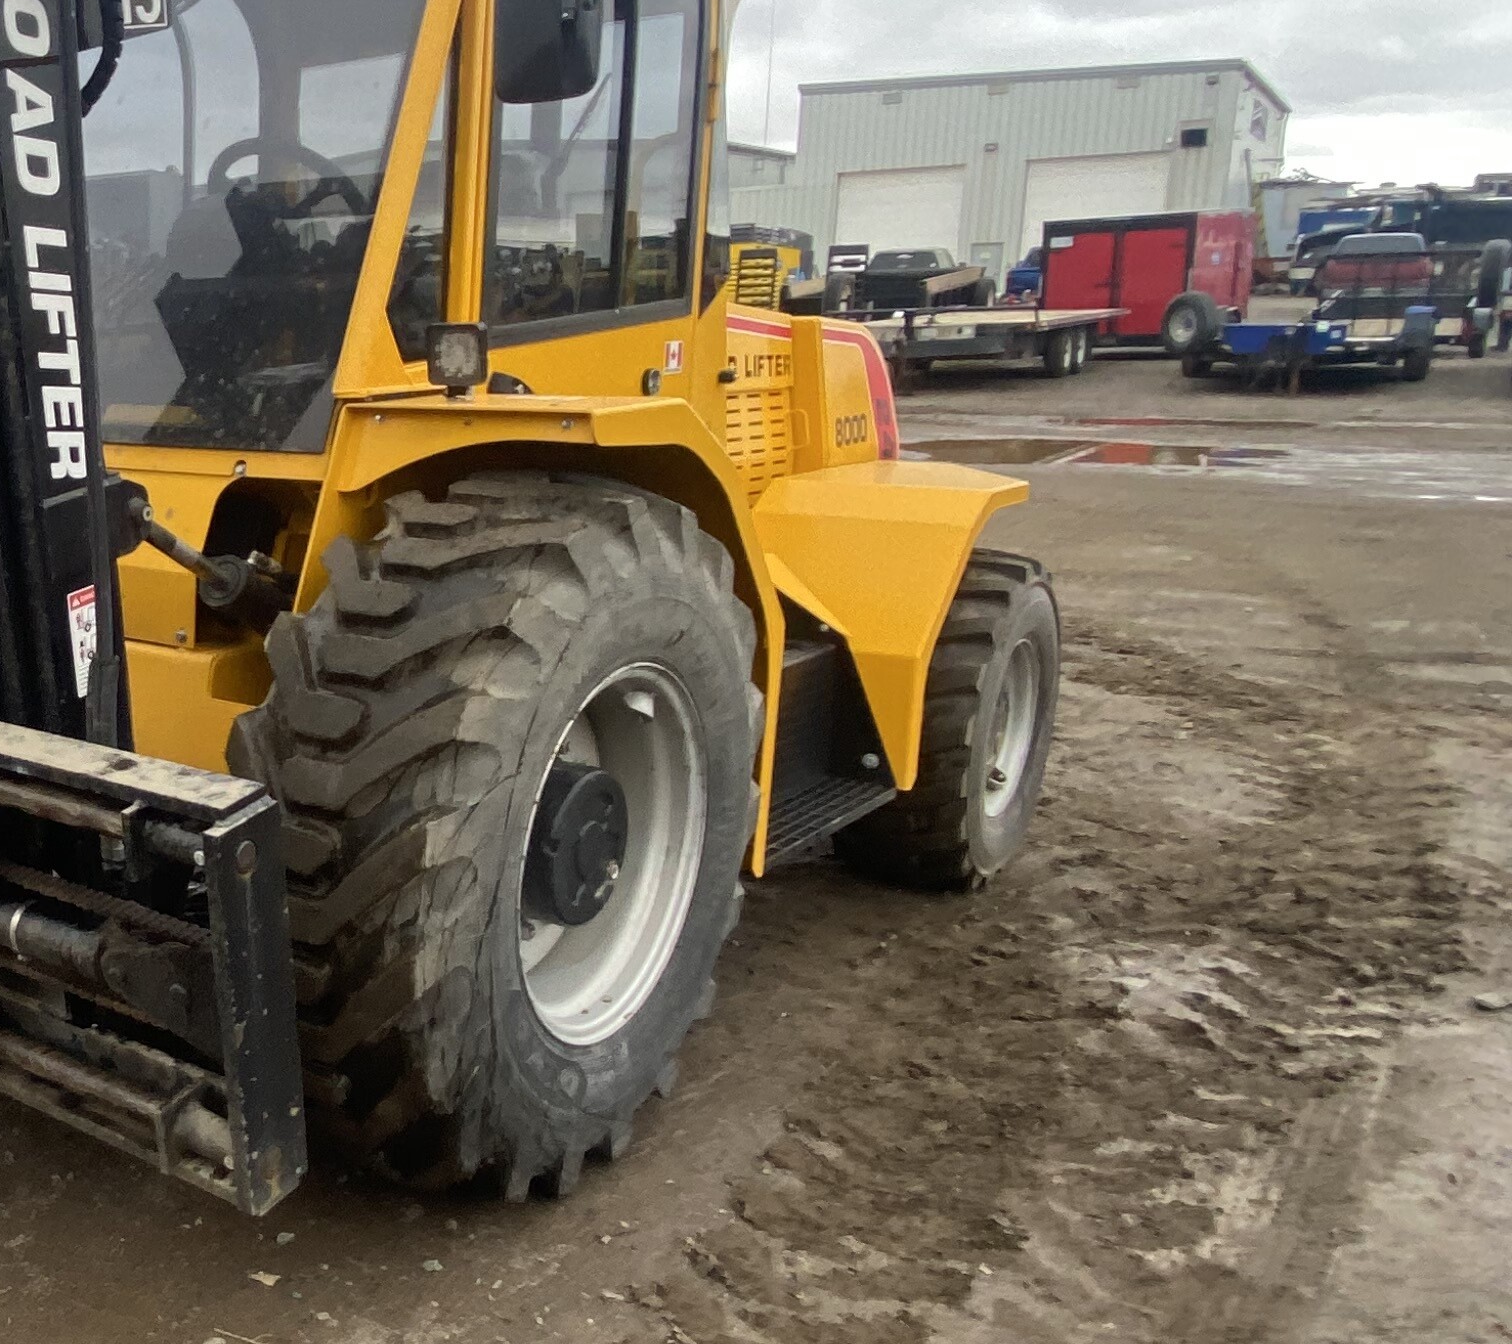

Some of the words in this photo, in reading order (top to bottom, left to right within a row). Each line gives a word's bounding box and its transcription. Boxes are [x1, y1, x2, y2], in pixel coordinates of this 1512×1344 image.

[22, 224, 89, 481] LIFTER
[744, 354, 791, 378] LIFTER
[835, 413, 867, 447] 8000
